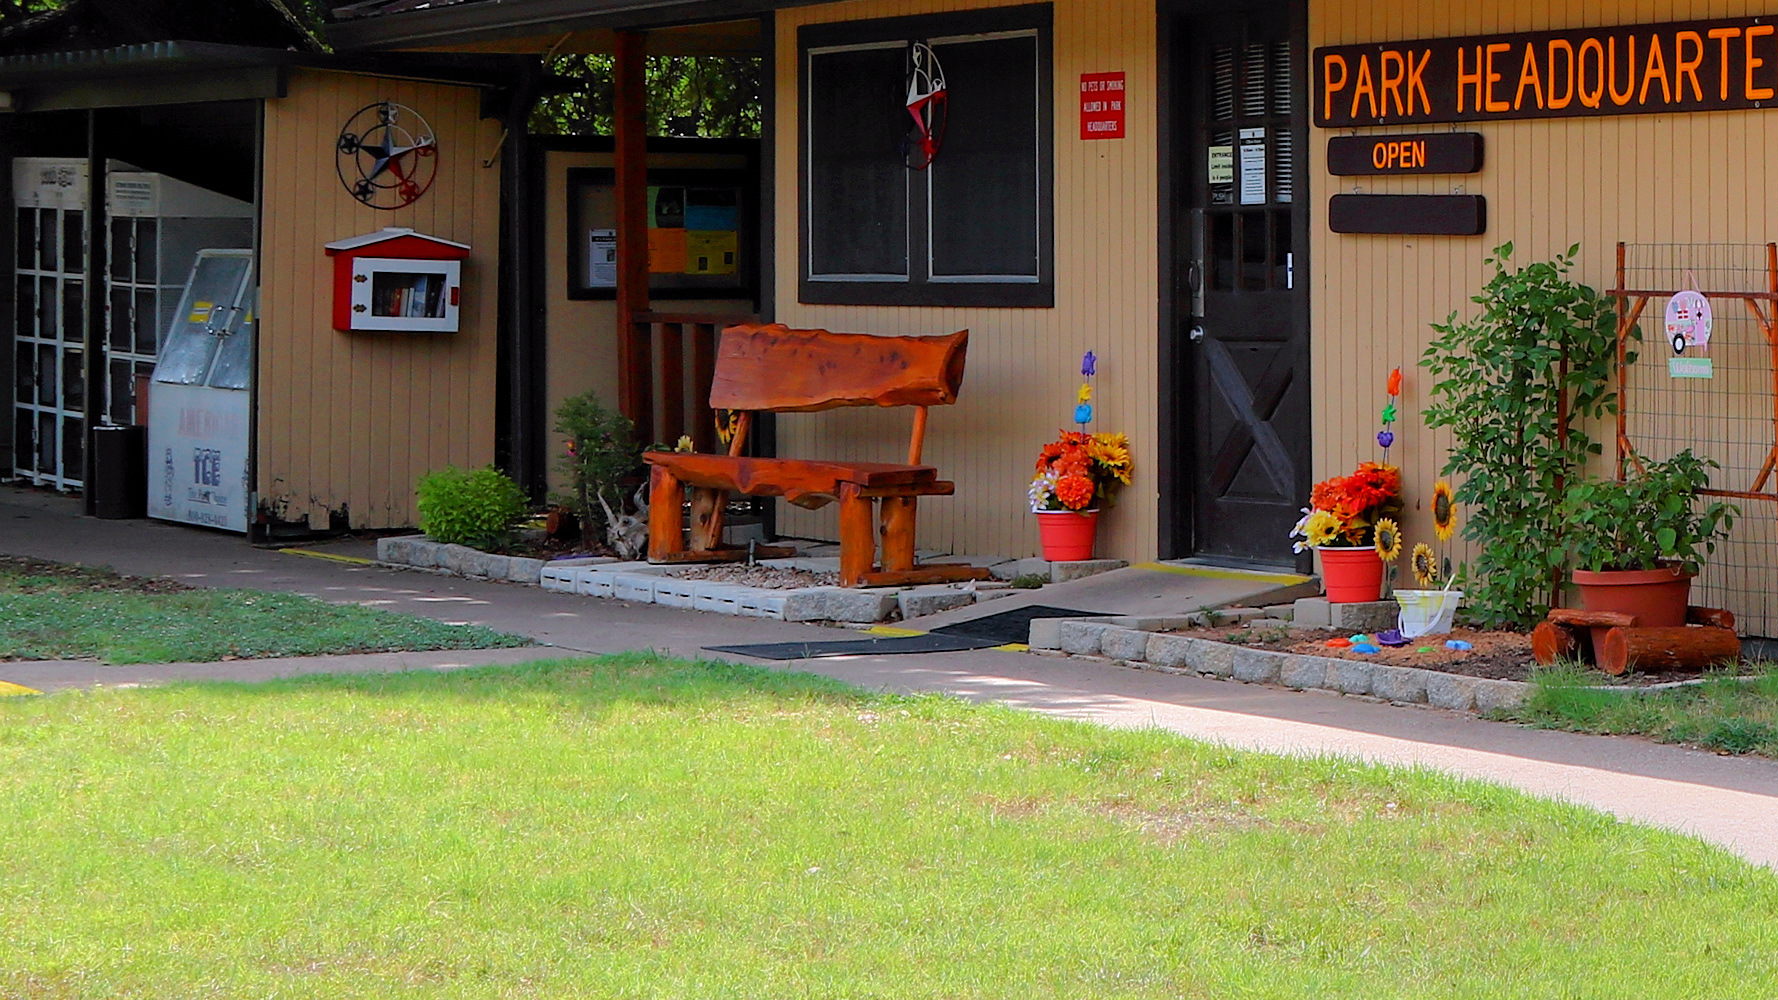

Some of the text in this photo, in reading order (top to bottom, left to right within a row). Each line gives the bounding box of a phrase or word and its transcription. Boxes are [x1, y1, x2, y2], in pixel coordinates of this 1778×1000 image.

[1081, 80, 1124, 92] NO PETS OR SMOKING
[1324, 48, 1431, 121] PARK
[1083, 100, 1121, 112] ALLOWED IN PARK
[1087, 121, 1117, 131] HEADQUARTERS
[1372, 140, 1425, 169] OPEN
[194, 446, 221, 486] ICE
